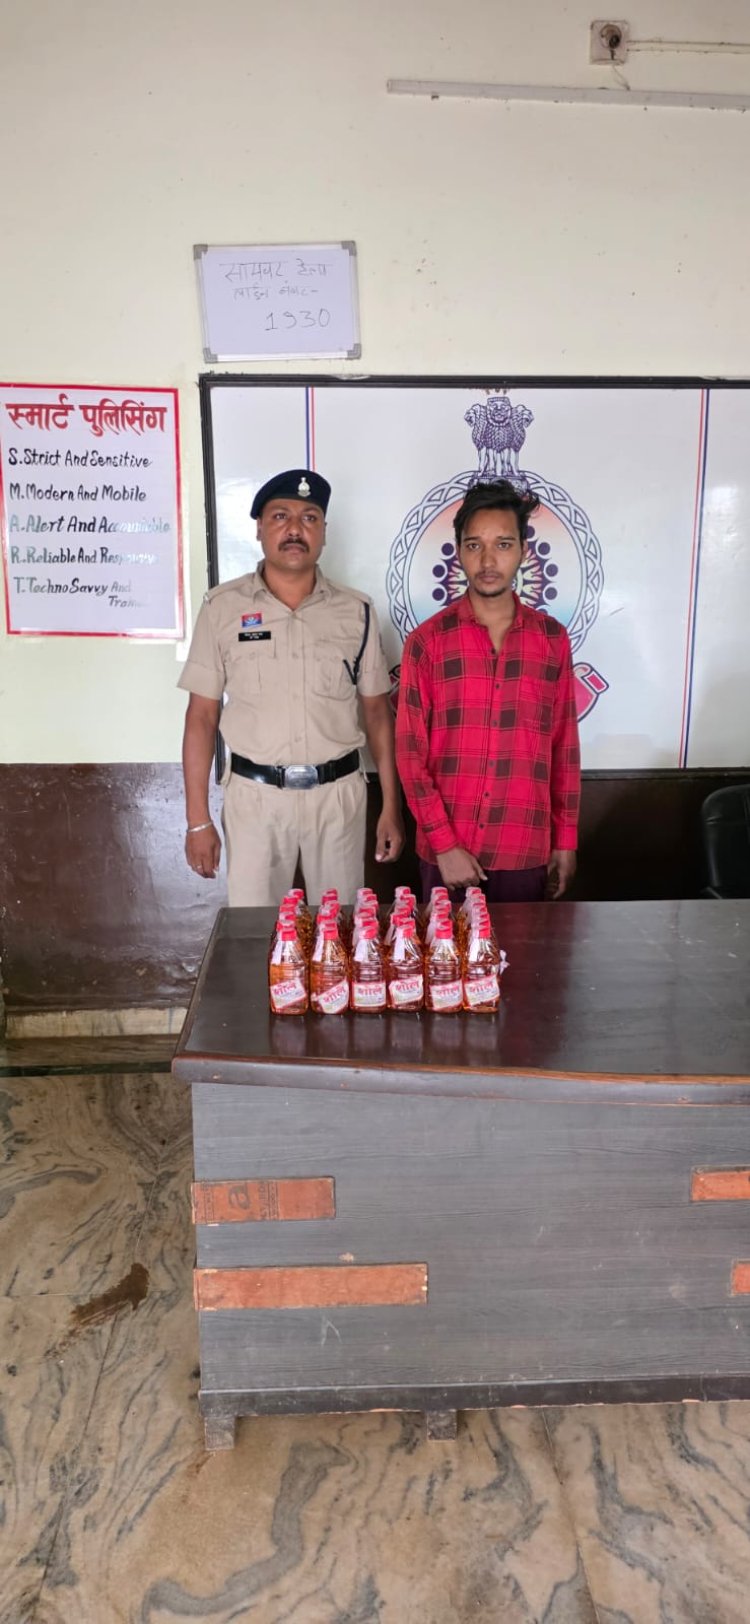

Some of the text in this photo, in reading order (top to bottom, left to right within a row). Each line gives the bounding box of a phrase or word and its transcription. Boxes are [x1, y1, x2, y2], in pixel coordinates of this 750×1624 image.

[265, 308, 331, 331] 1930
[5, 393, 167, 437] स्मार्ट पुलिसिंग
[65, 450, 88, 467] And
[90, 450, 152, 468] Sensitive
[77, 483, 99, 501] And
[101, 484, 147, 501] Mobile
[67, 515, 96, 533] And
[77, 547, 97, 564] And
[69, 577, 109, 596] Savvy
[110, 581, 131, 593] And
